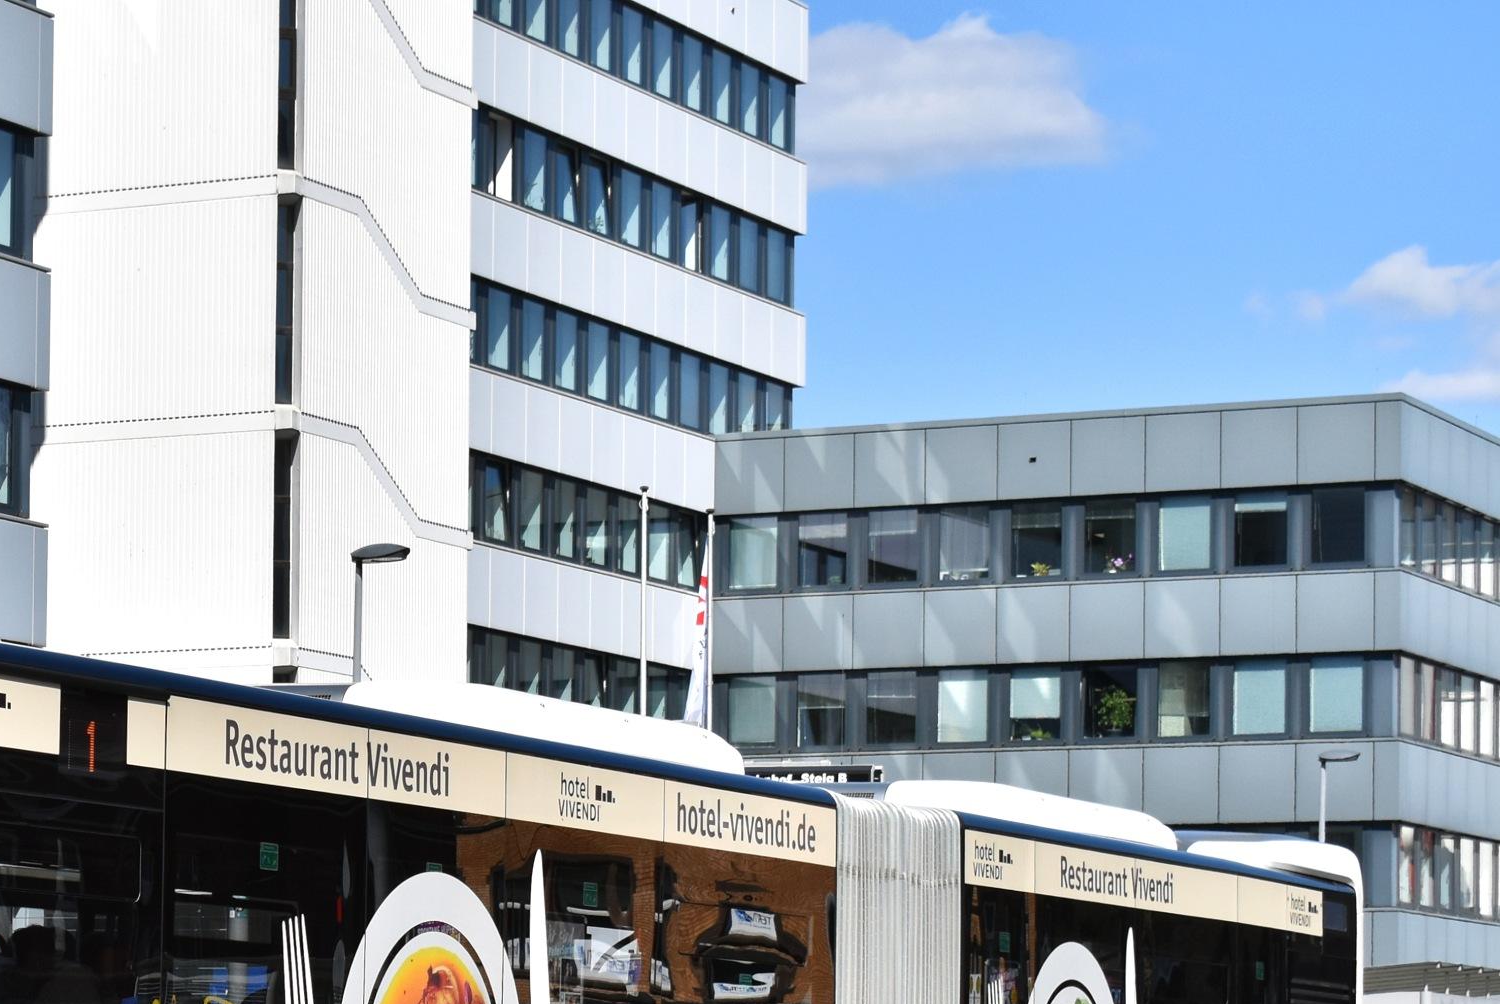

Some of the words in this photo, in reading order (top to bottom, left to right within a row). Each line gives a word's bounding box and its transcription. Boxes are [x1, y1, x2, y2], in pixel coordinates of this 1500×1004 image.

[86, 720, 97, 773] 1
[225, 719, 360, 785] Restaurant
[367, 741, 450, 797] Vivendi
[560, 772, 590, 800] hotel
[837, 772, 848, 784] B
[558, 798, 601, 822] VIVENDI
[676, 792, 816, 852] hotel-vivendi.de
[974, 839, 996, 862] hotel
[973, 862, 1003, 881] VIVENDI
[1060, 855, 1128, 898] Restaurant
[1131, 866, 1174, 904] Vivendi
